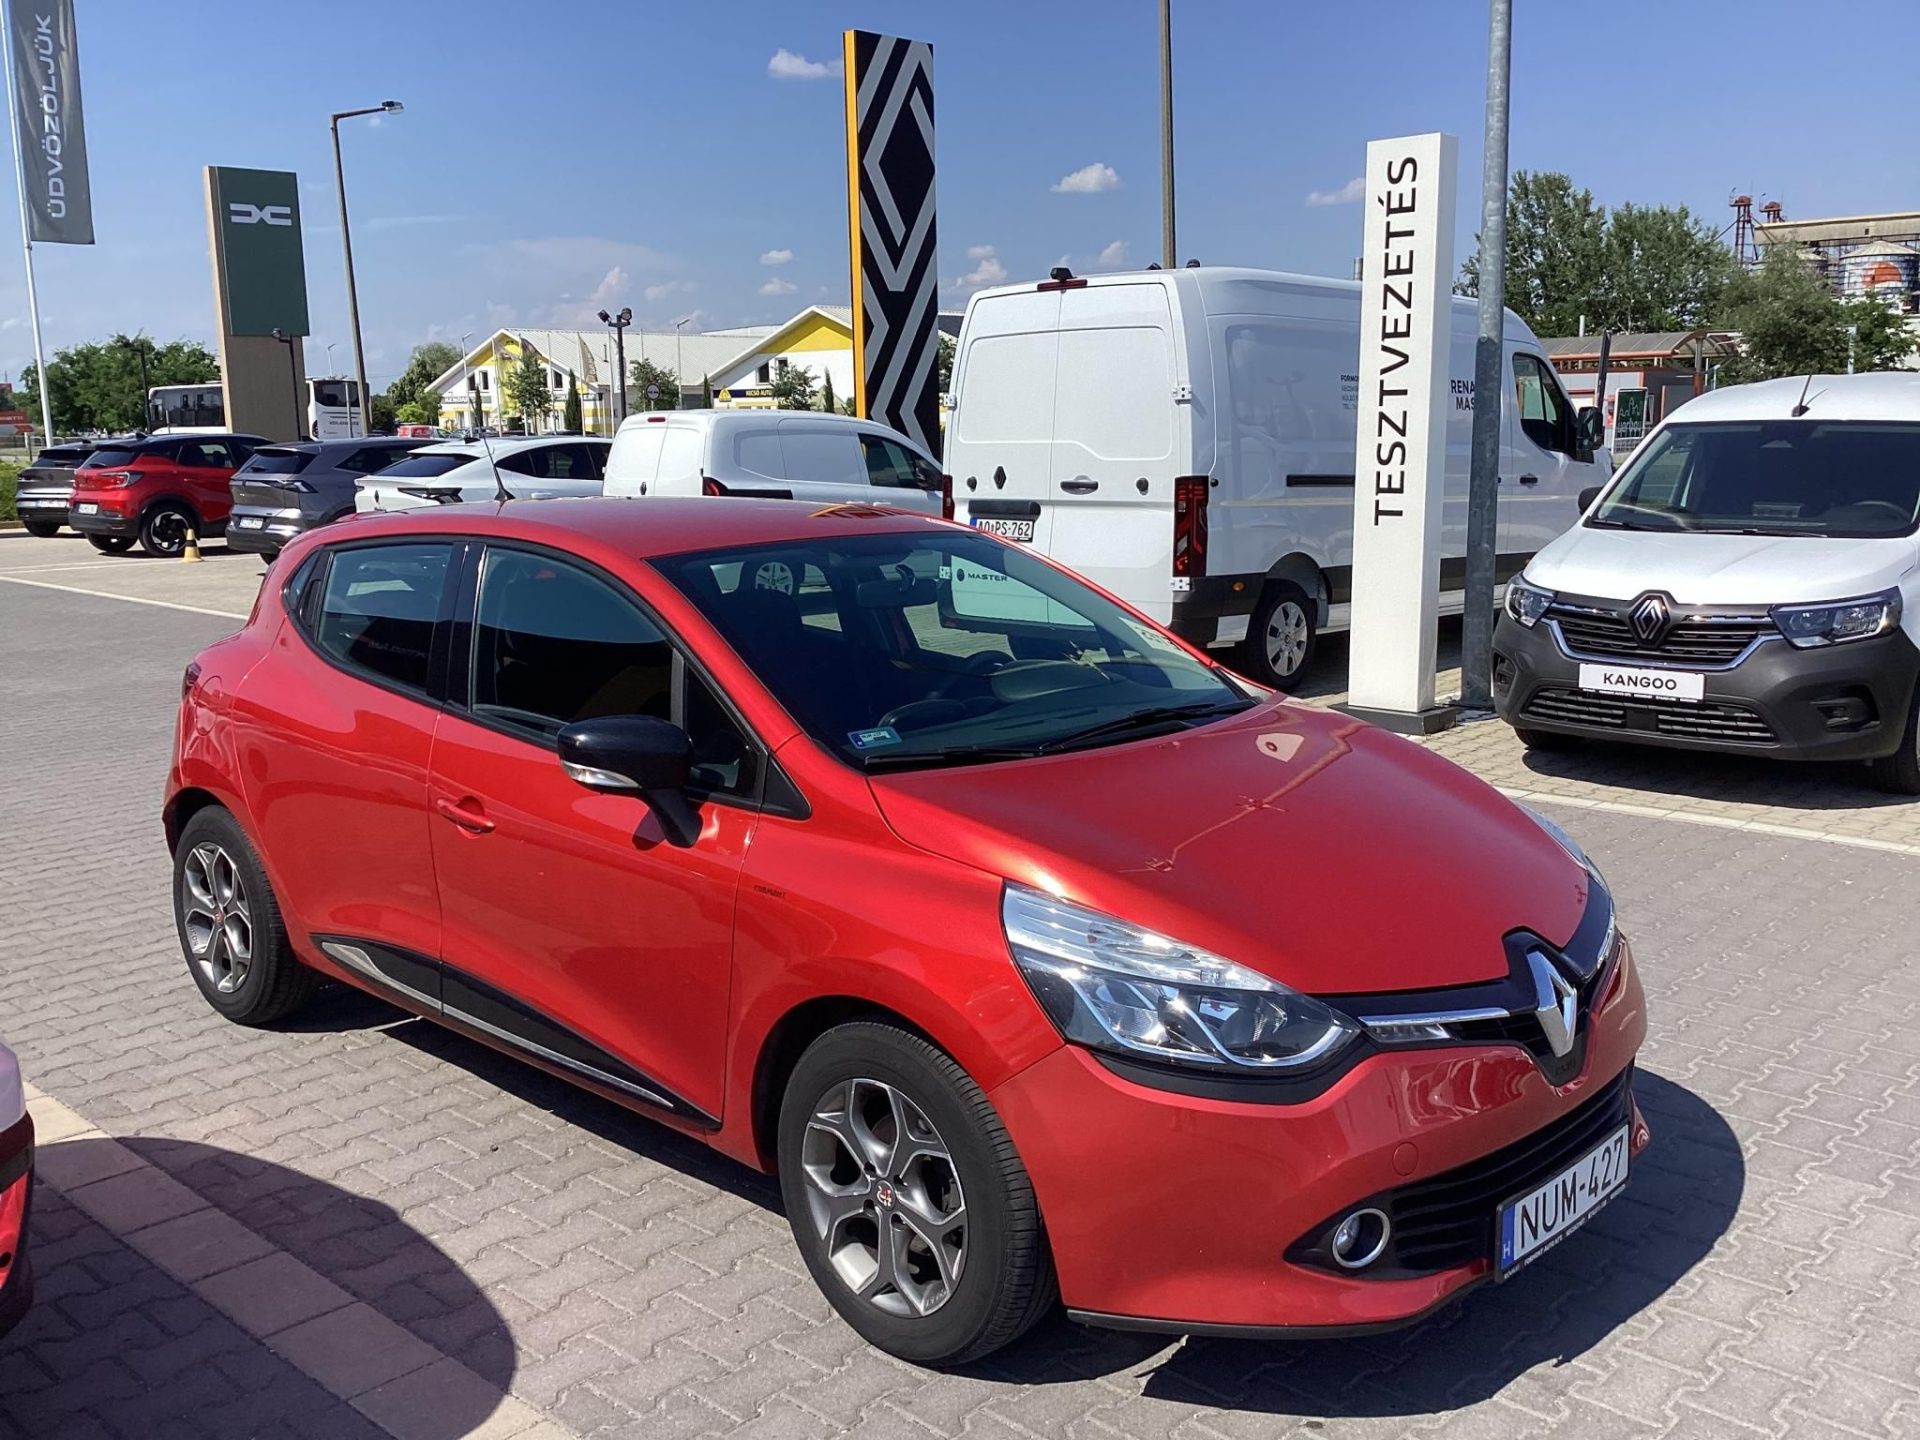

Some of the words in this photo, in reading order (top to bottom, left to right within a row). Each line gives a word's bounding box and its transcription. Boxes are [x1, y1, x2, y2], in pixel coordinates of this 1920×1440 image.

[34, 13, 66, 219] ÜDVÖZÖLJÜK
[1374, 156, 1418, 526] TESZTVEZETÉS
[1450, 379, 1475, 394] RENA
[1456, 396, 1475, 411] MAS
[967, 572, 1007, 582] MASTER
[1603, 672, 1677, 691] KANGOO
[1520, 1134, 1624, 1249] NUM-427
[1502, 1240, 1511, 1259] H
